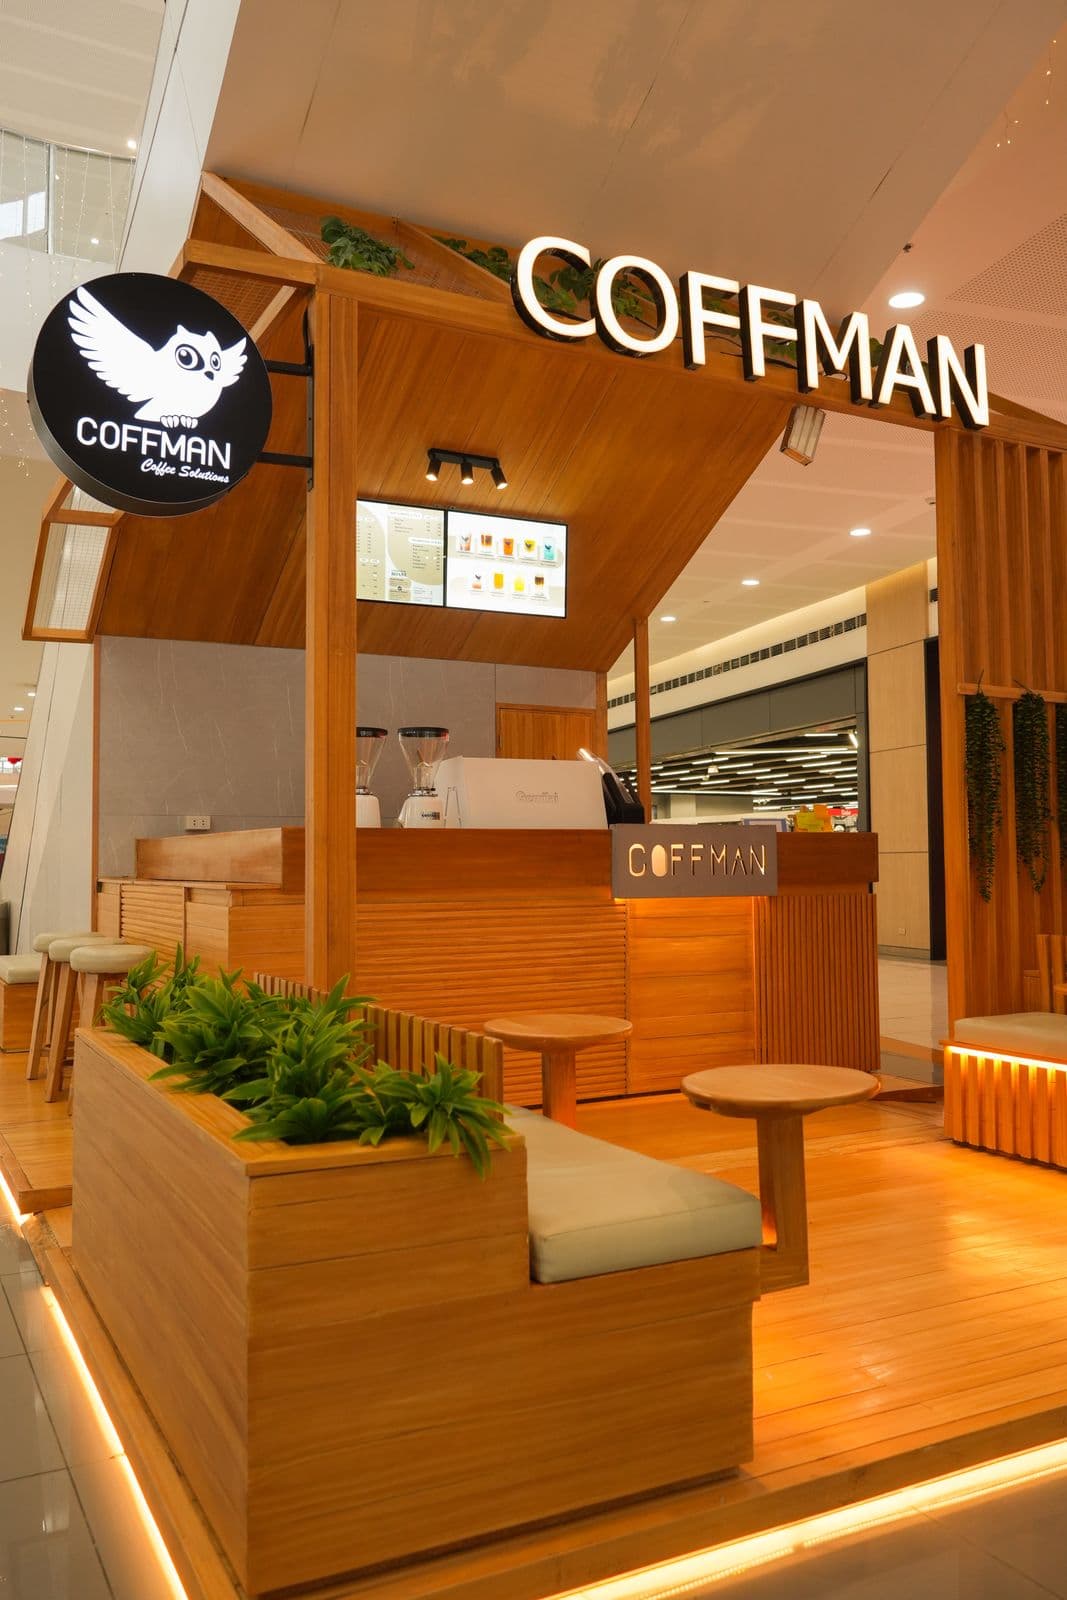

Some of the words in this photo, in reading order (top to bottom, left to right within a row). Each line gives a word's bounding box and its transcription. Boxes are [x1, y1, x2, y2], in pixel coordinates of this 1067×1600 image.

[515, 235, 990, 427] COFFMAN
[76, 416, 231, 470] COFFMAN
[140, 458, 176, 476] Coffee
[178, 466, 230, 484] Solutions
[628, 843, 766, 877] COFFMAN
